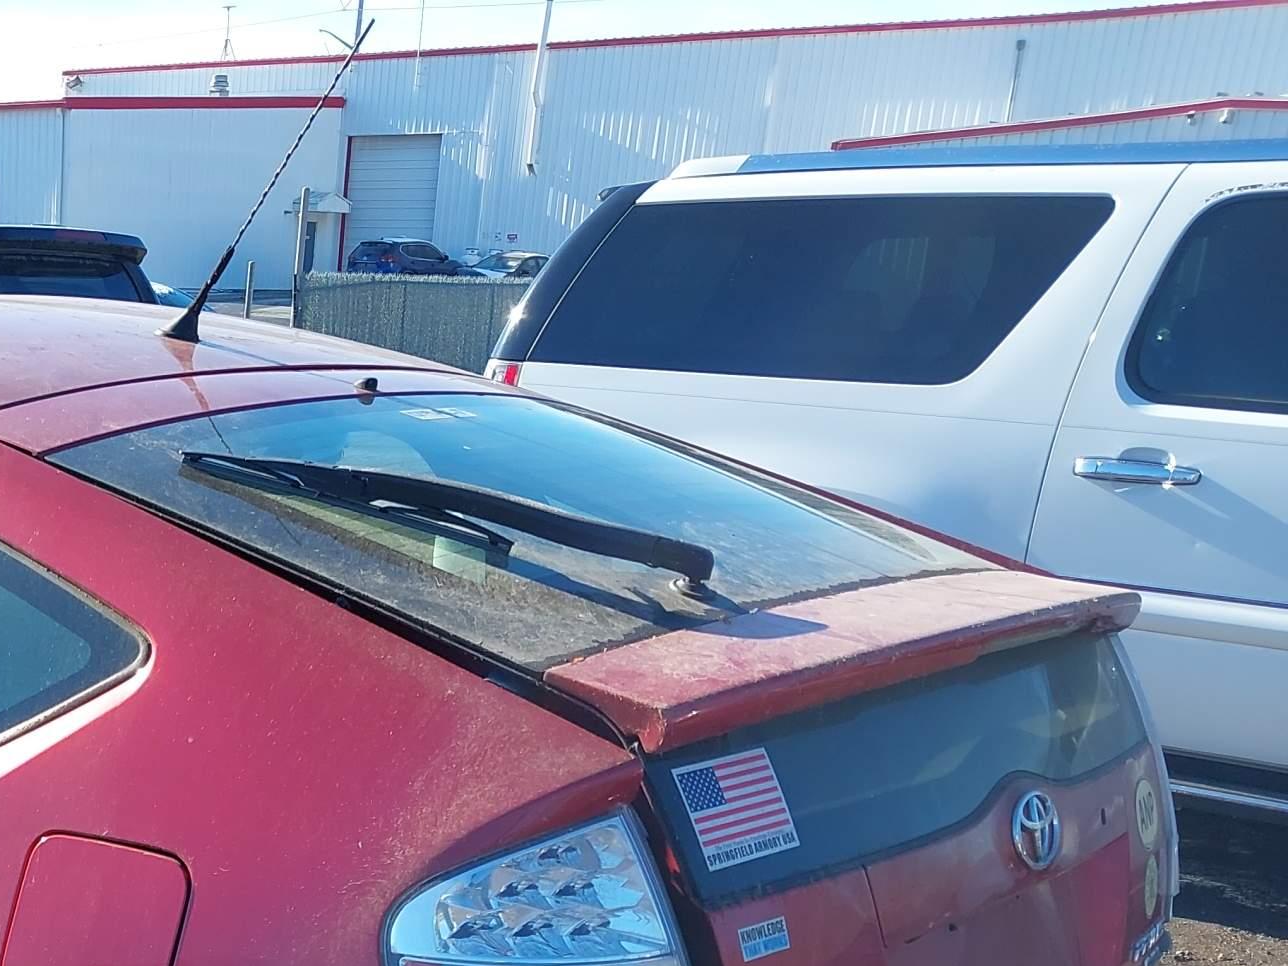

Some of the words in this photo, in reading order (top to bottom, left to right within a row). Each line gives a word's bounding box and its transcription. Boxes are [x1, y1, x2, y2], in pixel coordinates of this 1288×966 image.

[707, 844, 754, 867] SPRINGFIELD
[754, 834, 783, 853] ARMORY
[783, 832, 796, 845] USA
[740, 919, 785, 945] KNOWLEDGE
